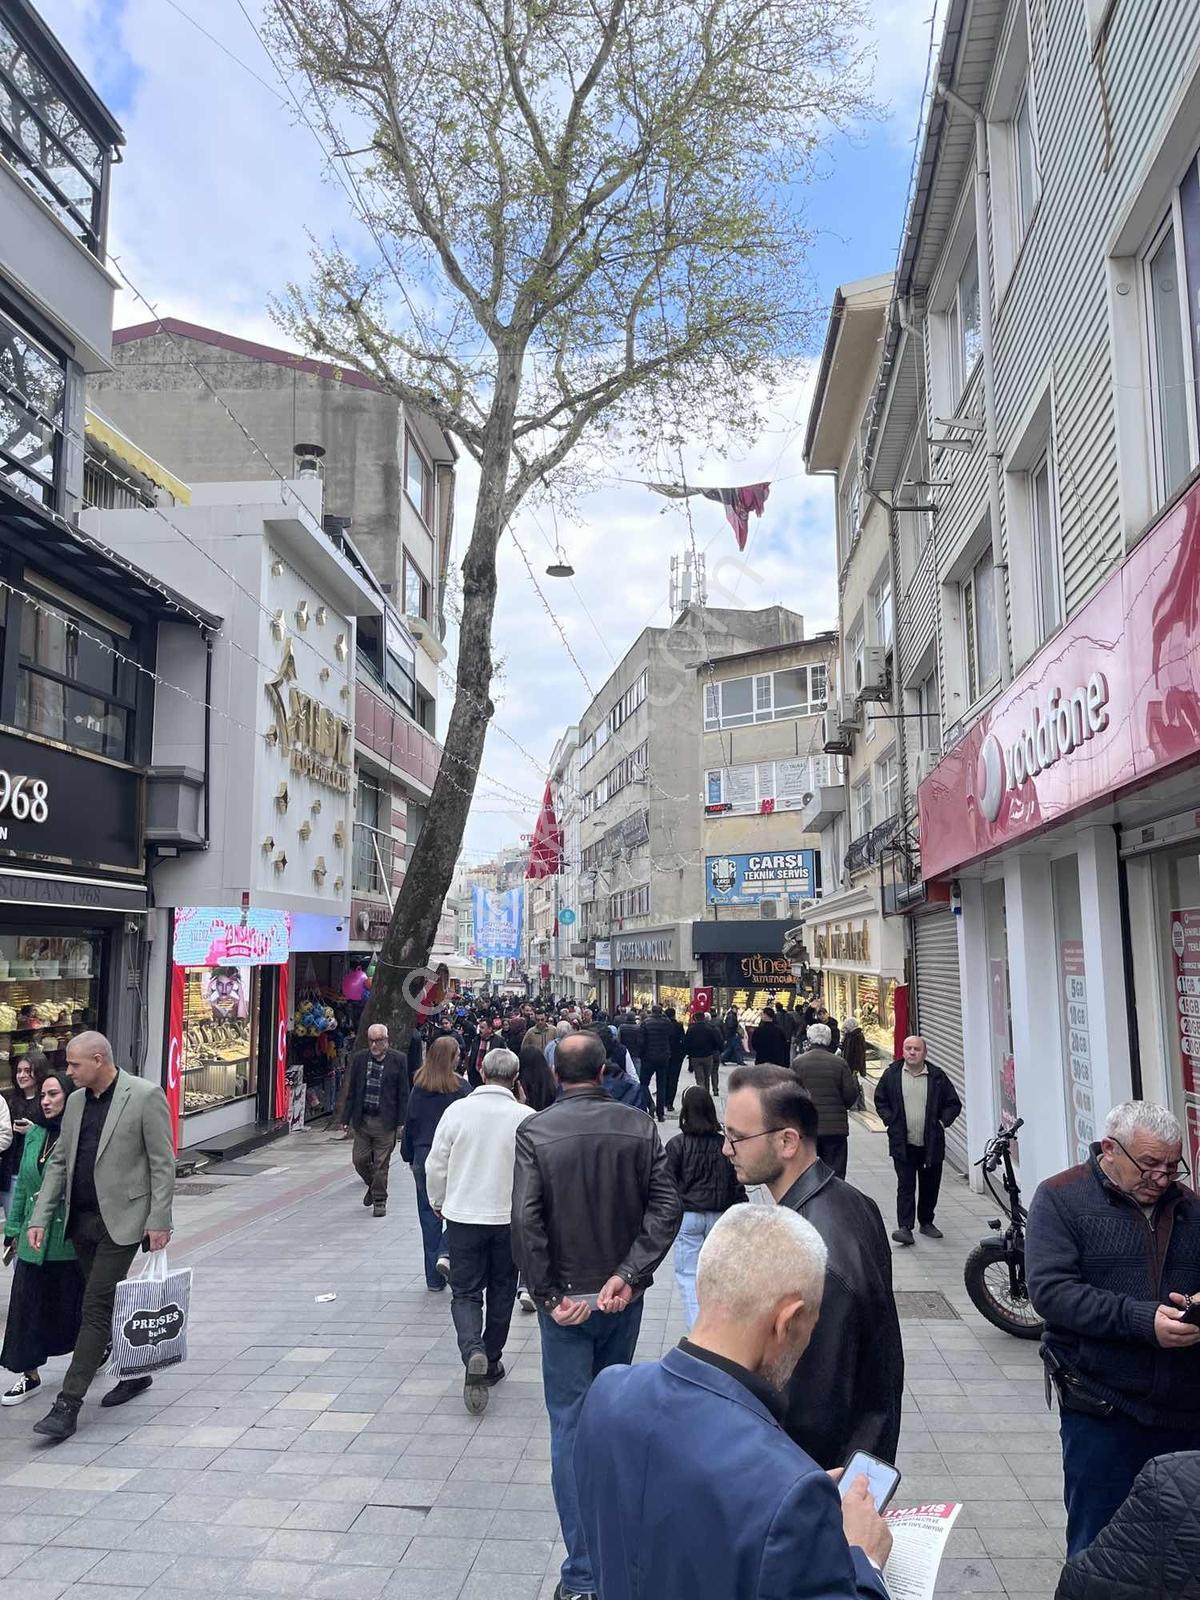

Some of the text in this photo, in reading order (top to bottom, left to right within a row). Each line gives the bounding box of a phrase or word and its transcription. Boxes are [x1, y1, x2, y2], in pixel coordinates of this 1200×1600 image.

[1006, 672, 1110, 790] vodafone
[749, 855, 803, 870] ÇARŞI
[744, 868, 809, 881] TEKNİK SERVİS
[71, 885, 100, 903] 1968
[1186, 1038, 1200, 1055] 30G
